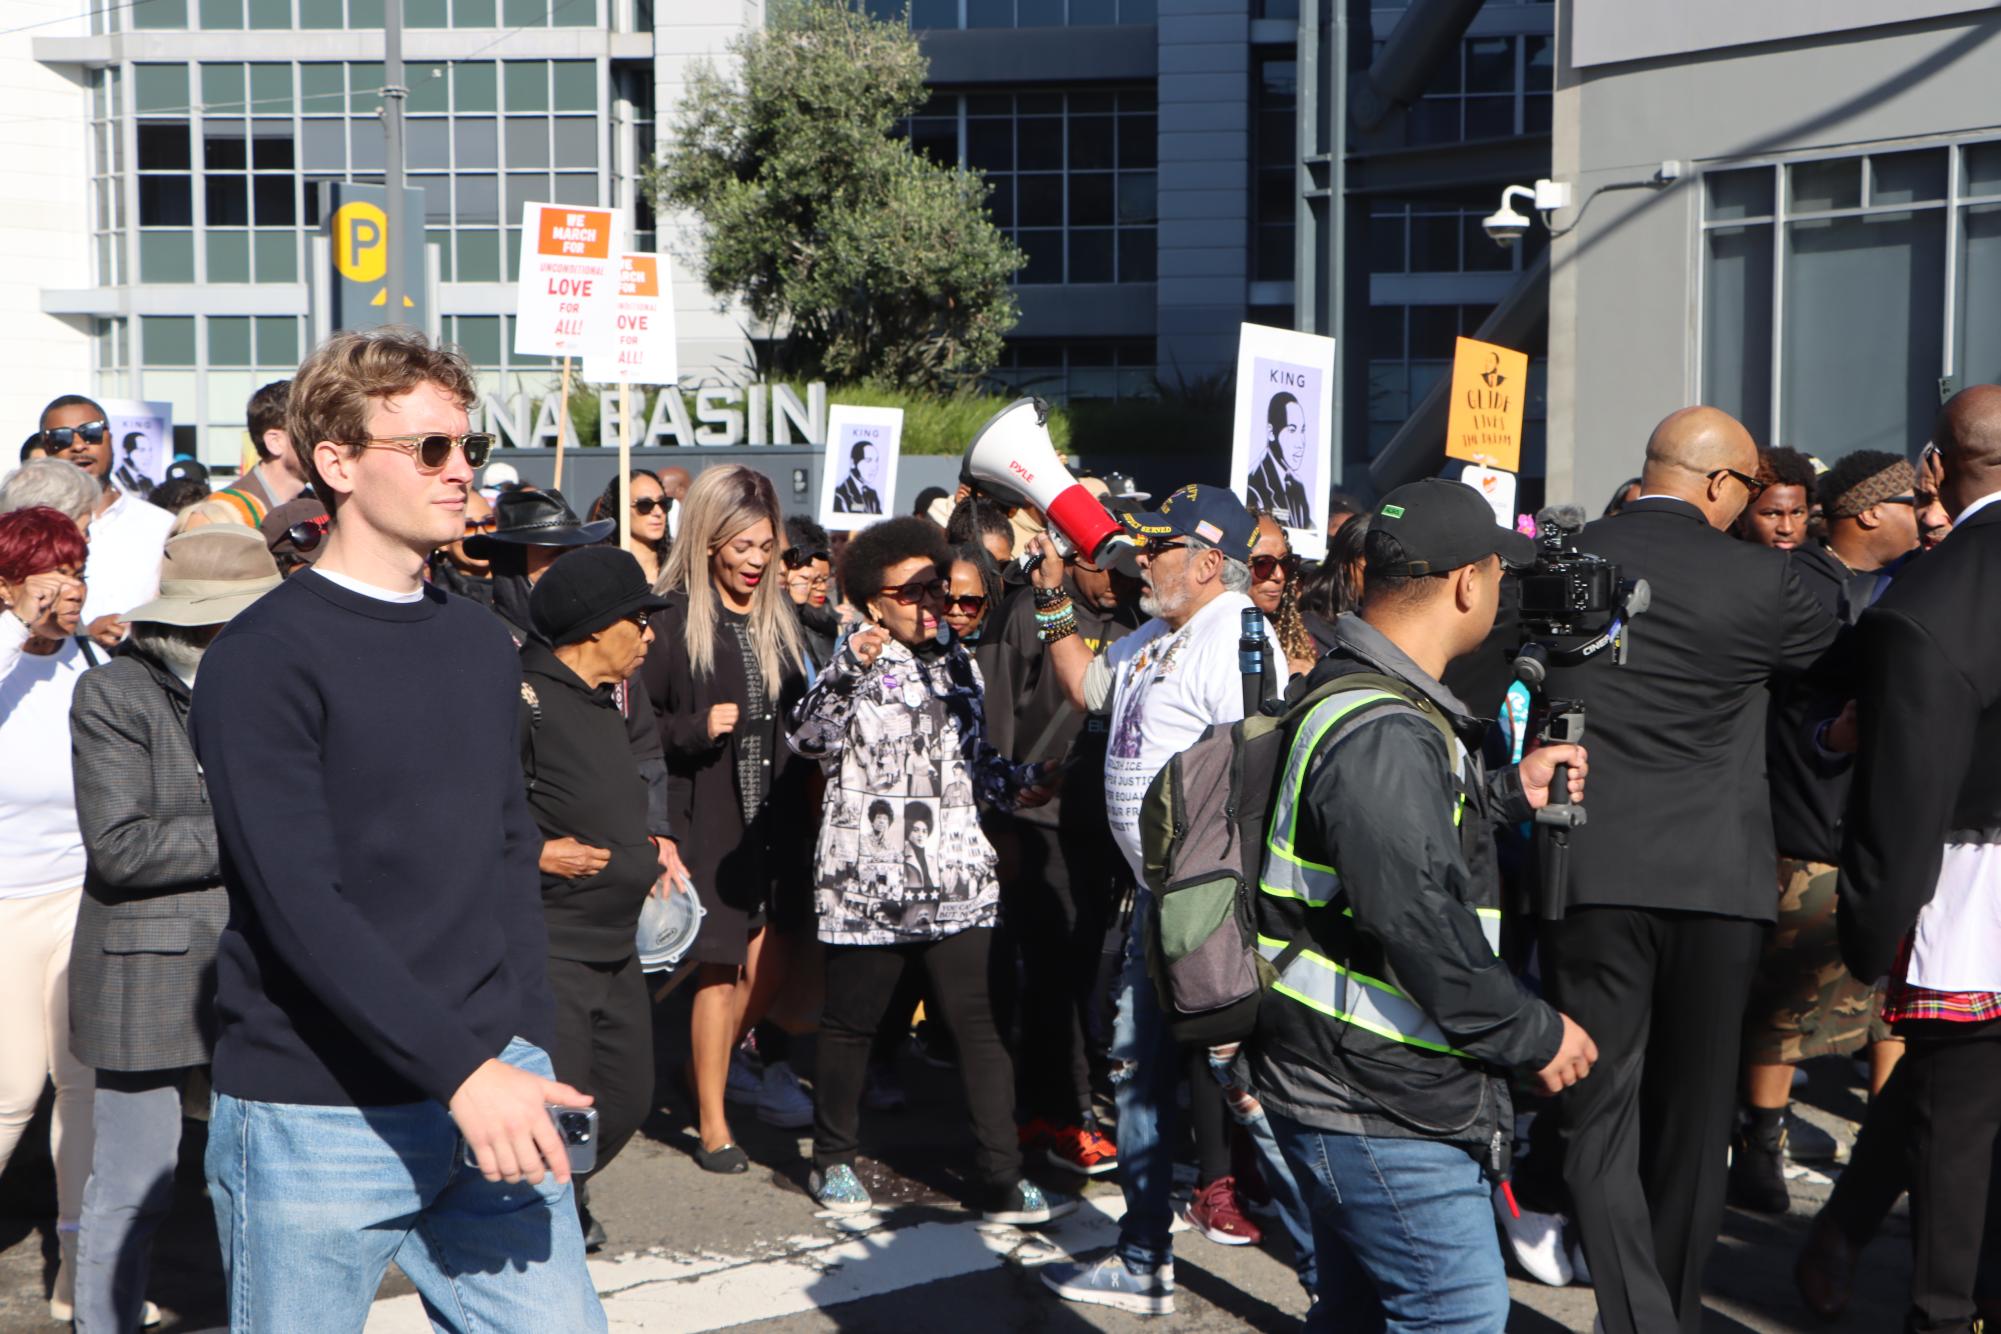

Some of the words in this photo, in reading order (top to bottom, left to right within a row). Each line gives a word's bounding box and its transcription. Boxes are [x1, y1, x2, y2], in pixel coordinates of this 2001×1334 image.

[566, 213, 586, 226] WE
[552, 226, 597, 242] MARCH
[350, 218, 380, 267] P
[562, 241, 585, 254] FOR
[547, 277, 593, 297] LOVE
[559, 302, 580, 313] FOR
[554, 319, 584, 336] ALL!
[616, 314, 649, 331] OVE
[620, 335, 639, 345] FOR
[618, 351, 644, 365] ALL!
[1270, 368, 1306, 389] KING
[600, 382, 827, 447] BASIN
[852, 429, 879, 438] KING
[1008, 460, 1035, 483] PYLE
